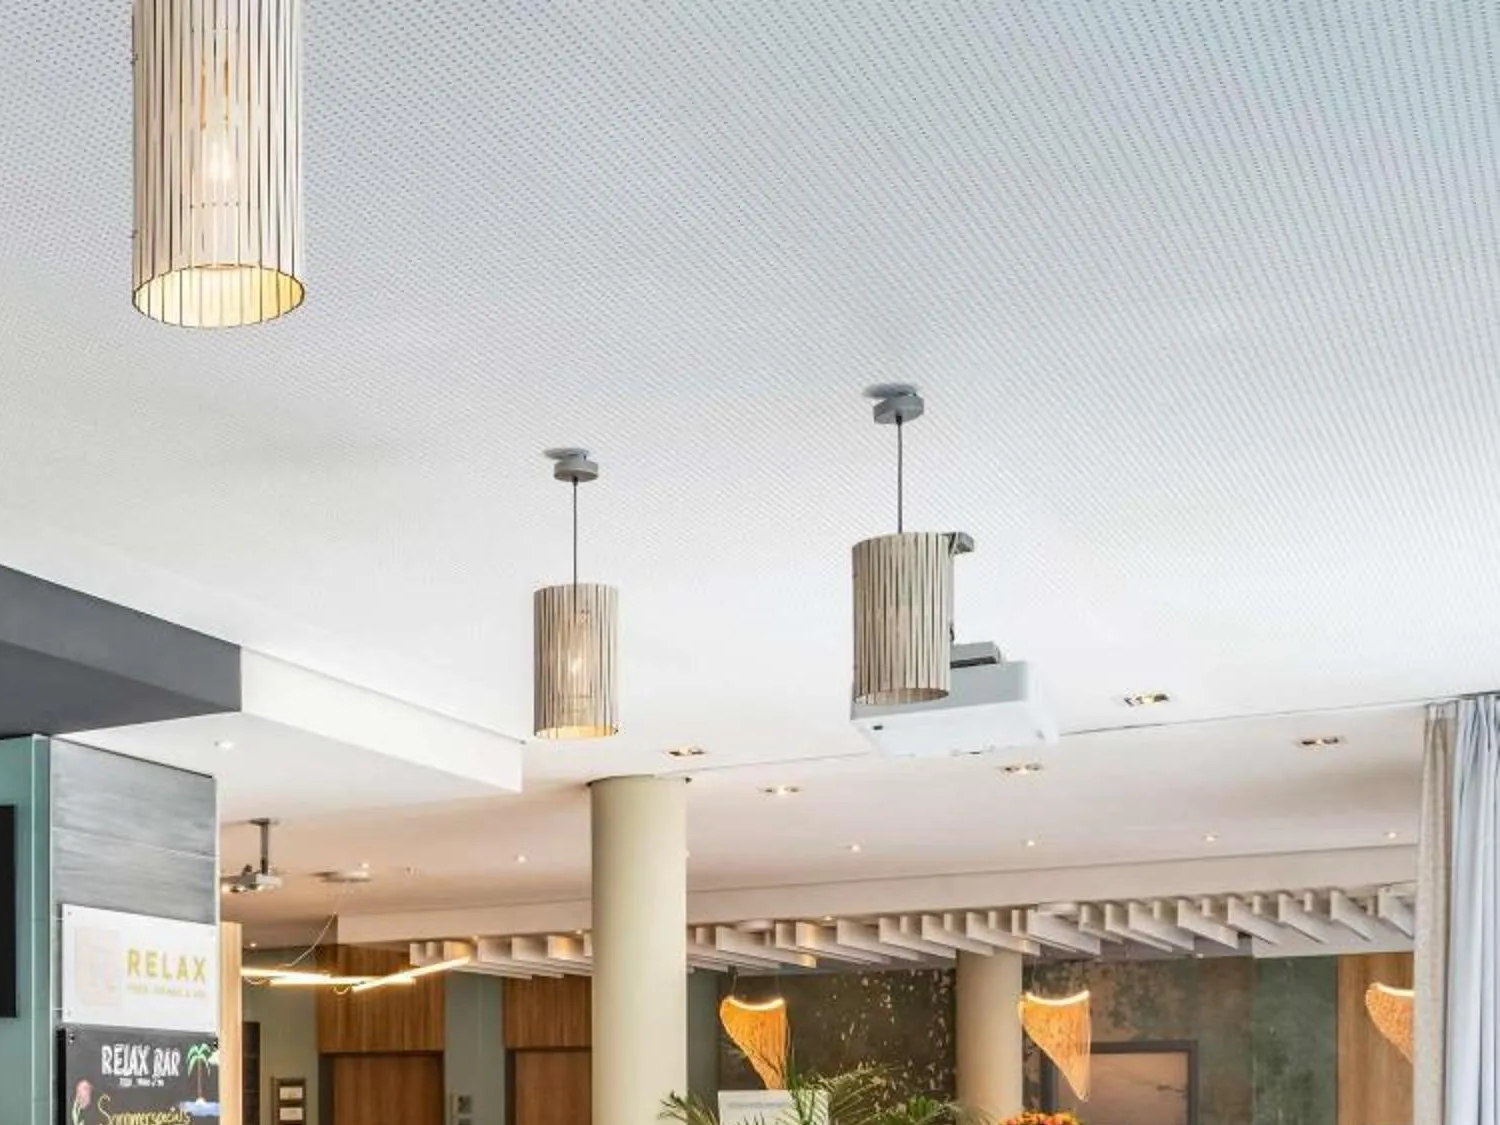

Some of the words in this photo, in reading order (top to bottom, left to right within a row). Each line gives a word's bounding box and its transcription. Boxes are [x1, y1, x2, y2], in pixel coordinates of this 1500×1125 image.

[127, 948, 206, 985] RELAX
[100, 1043, 150, 1076] RELAX
[152, 1048, 181, 1078] BAR
